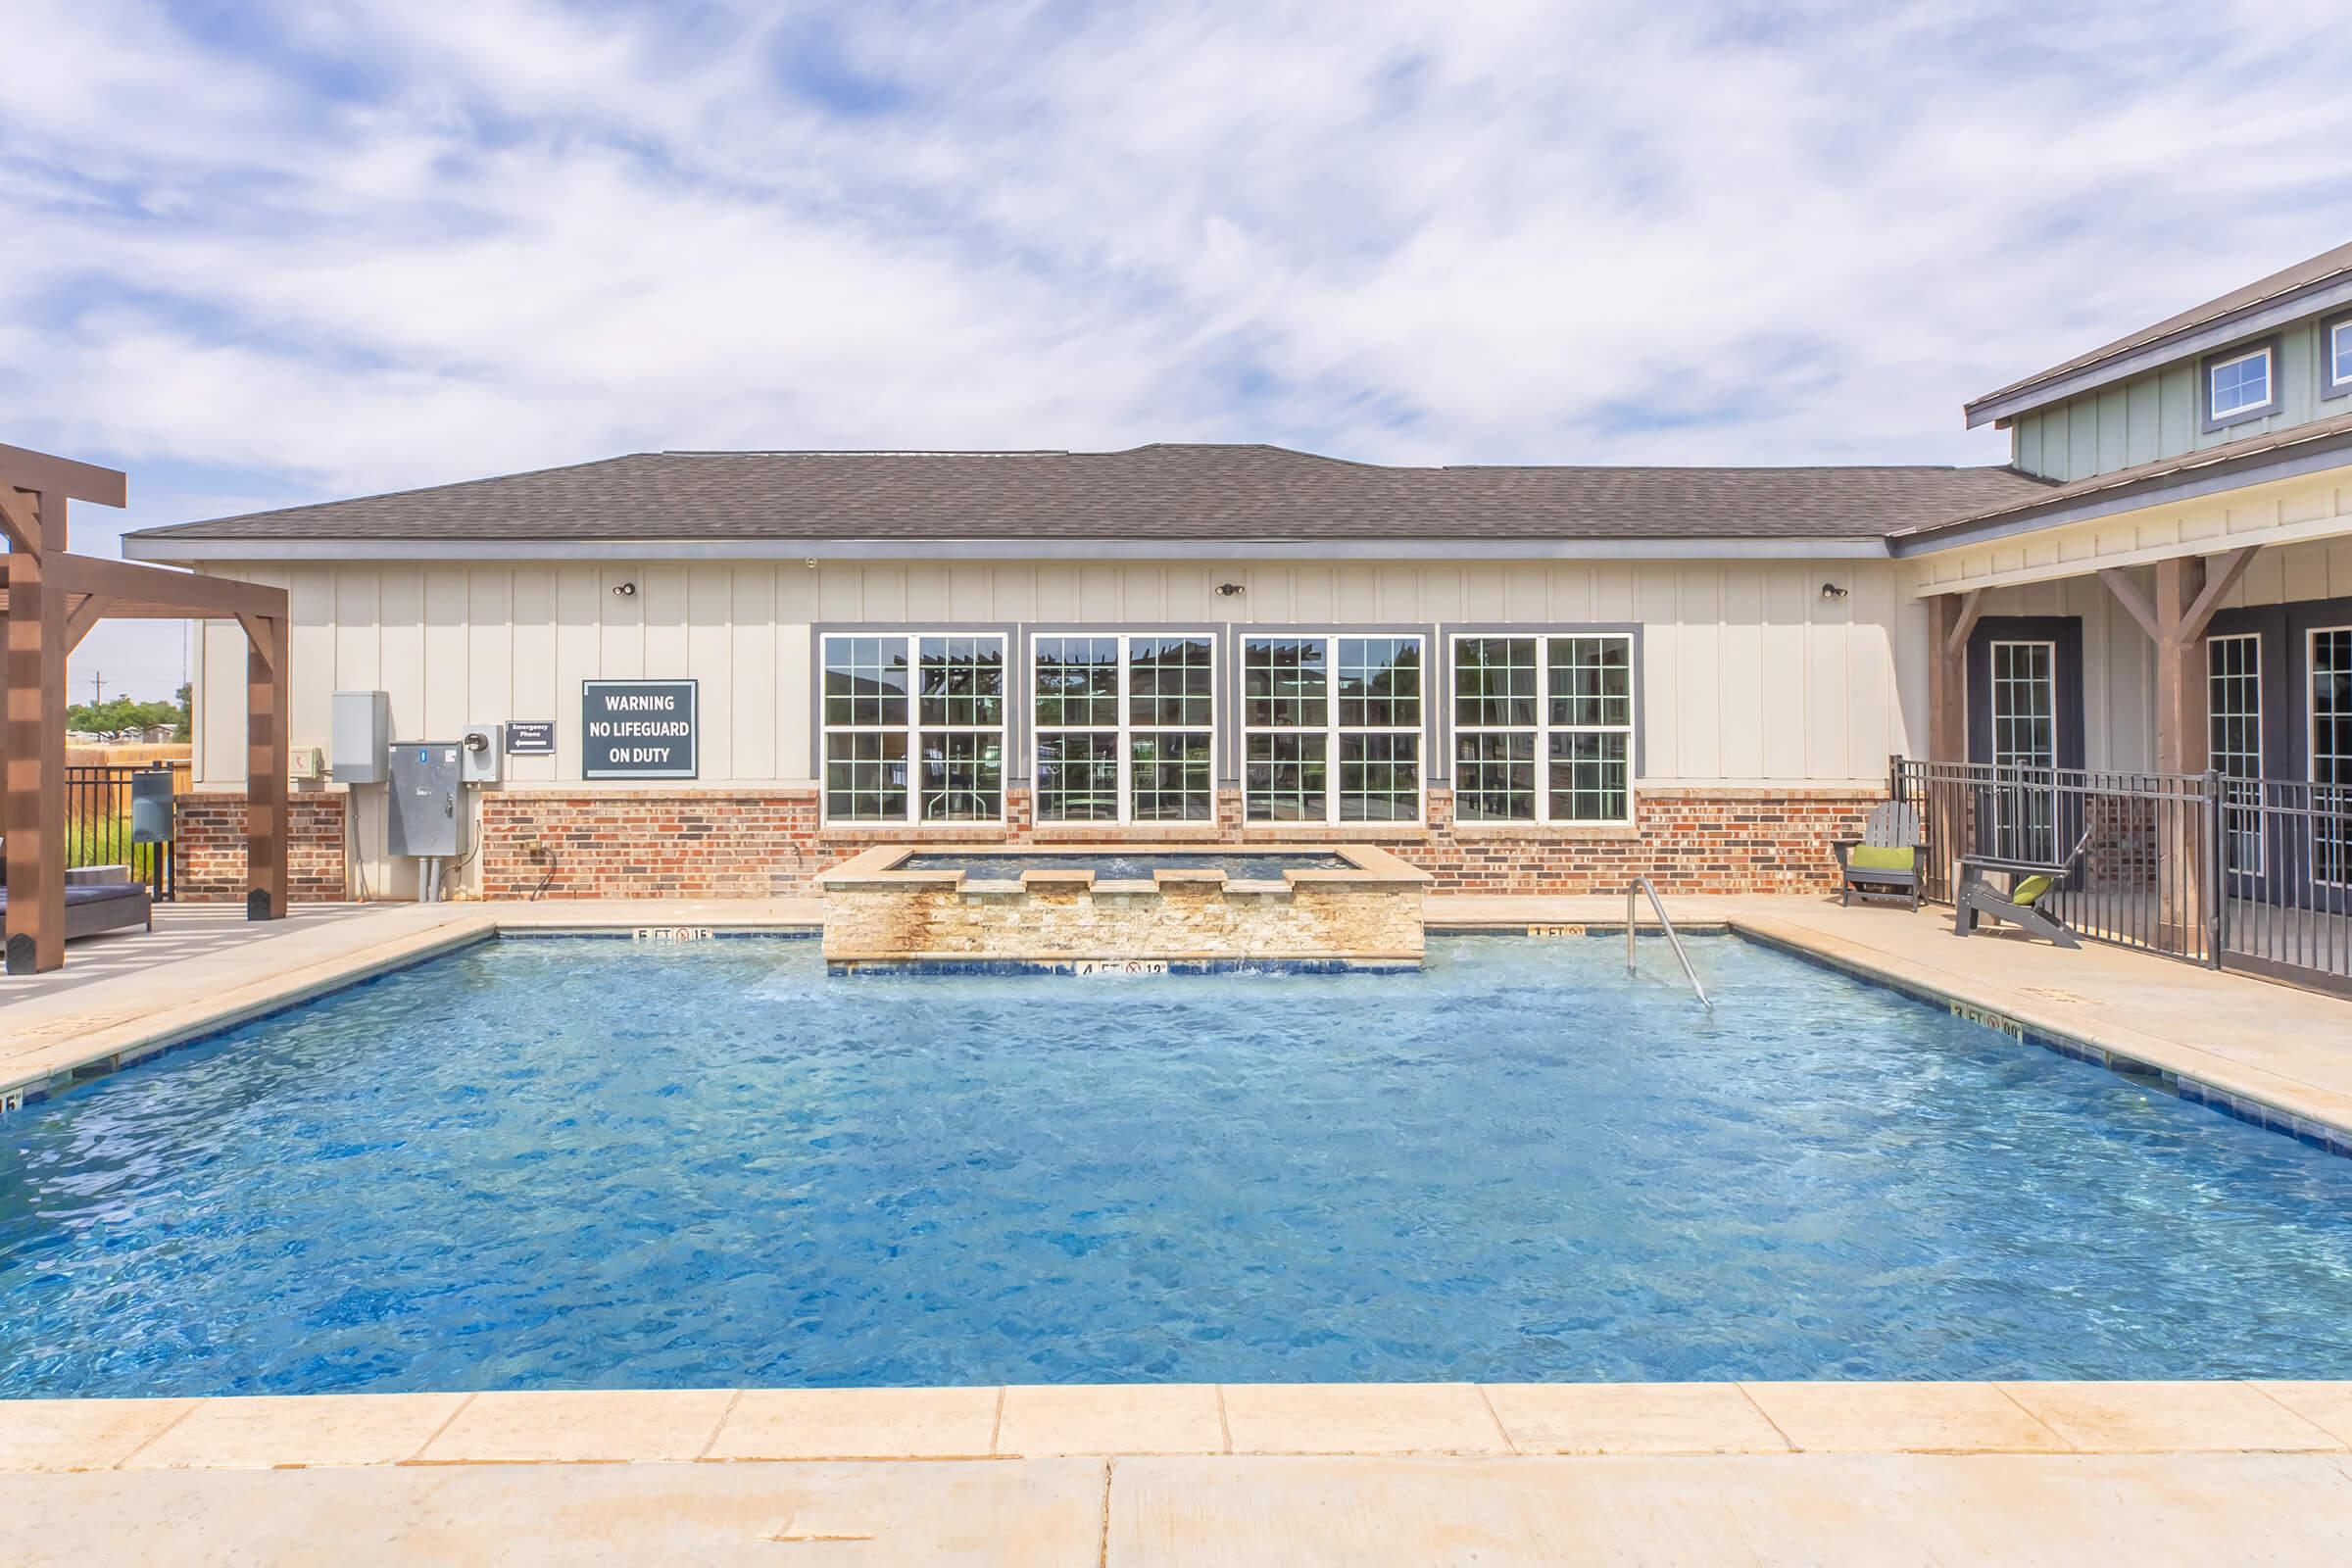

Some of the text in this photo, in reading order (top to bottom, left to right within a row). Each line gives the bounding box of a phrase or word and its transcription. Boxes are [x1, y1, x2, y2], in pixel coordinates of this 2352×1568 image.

[605, 696, 674, 710] WARNING
[589, 722, 689, 737] NO LIFEGUARD
[610, 748, 669, 762] ON DUTY
